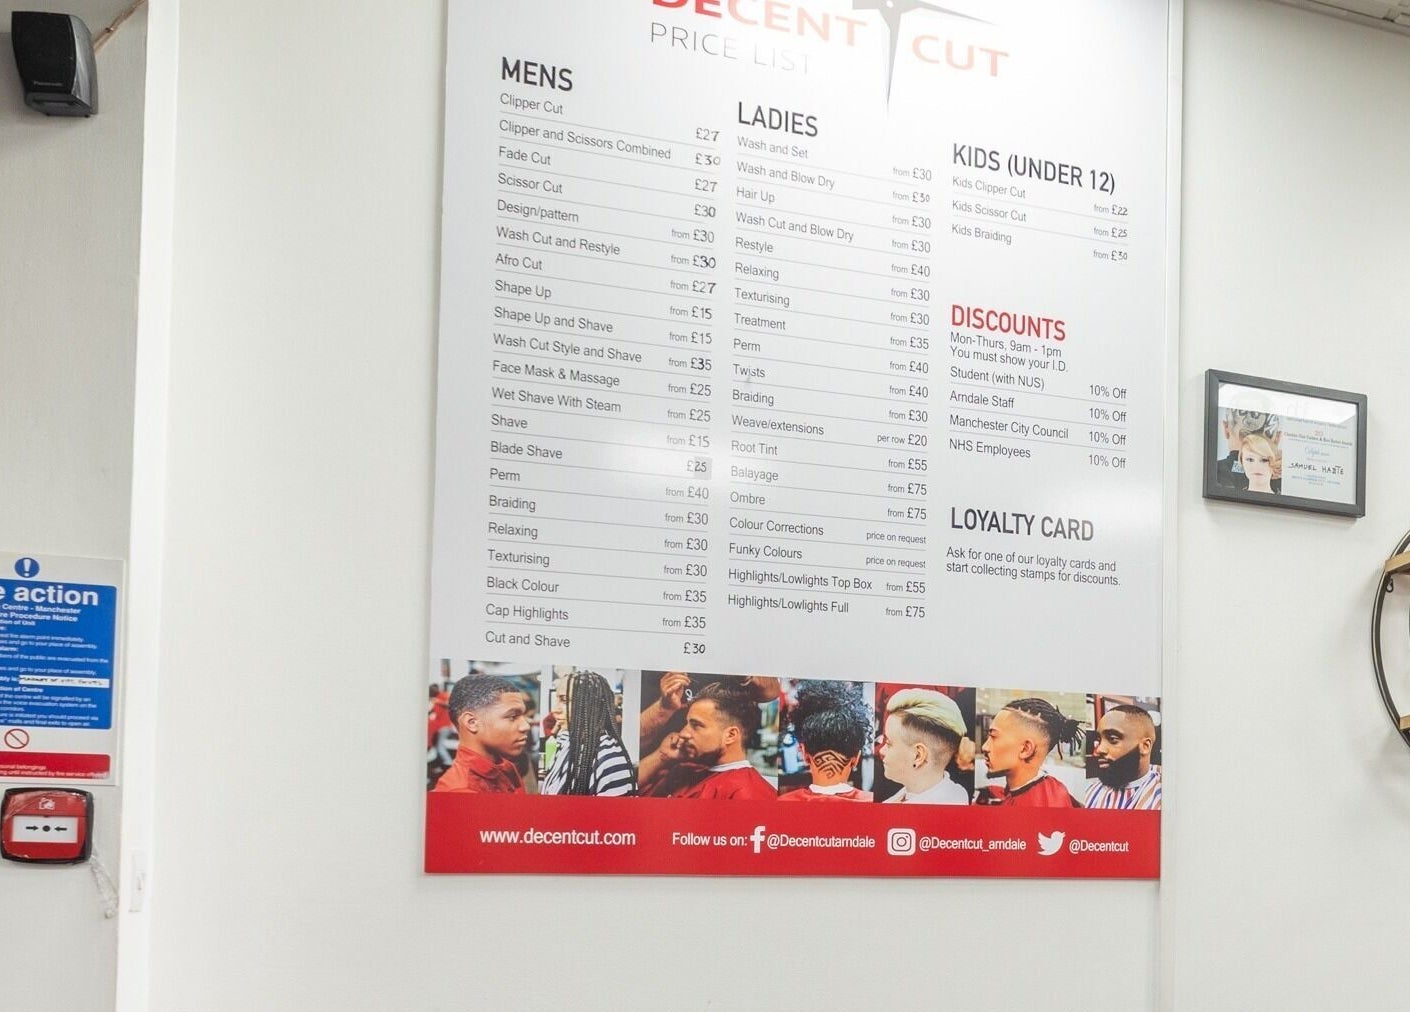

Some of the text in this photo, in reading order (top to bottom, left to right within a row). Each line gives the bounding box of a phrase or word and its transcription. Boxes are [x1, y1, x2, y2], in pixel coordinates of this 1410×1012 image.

[651, 0, 1009, 78] ECENT CUT
[651, 21, 810, 75] PRICE LIST
[501, 56, 573, 92] MENS
[500, 92, 719, 142] Clipper Cut £27
[738, 101, 818, 137] LADIES
[499, 119, 540, 138] Clipper
[543, 127, 564, 141] and
[567, 130, 613, 149] Scissors
[617, 140, 671, 160] Combined
[953, 143, 1115, 195] KIDS (UNDER 12)
[737, 187, 931, 229] Hair Up from £30
[953, 176, 973, 189] Kids
[975, 180, 1007, 195] Clipper
[1010, 186, 1026, 198] Cut
[1094, 204, 1109, 215] from
[497, 199, 714, 243] Design/pattern from £30
[953, 200, 972, 213] Kids
[975, 204, 1008, 219] Scissor
[1011, 210, 1026, 222] Cut
[1094, 227, 1109, 237] from
[952, 304, 1065, 342] DISCOUNTS
[950, 346, 970, 358] You
[973, 351, 997, 362] must
[1000, 354, 1025, 365] show
[1028, 358, 1050, 369] your
[1010, 340, 1031, 352] 9am
[1041, 345, 1061, 358] 1pm
[493, 361, 711, 397] Face Mask & Massage from £25
[950, 366, 1127, 399] Student (with NUS) 10% Off
[950, 390, 1127, 422] Arndale Staff 10% Off
[732, 415, 927, 446] Weave/extensions per row £20
[950, 414, 1126, 445] Manchester City Council 10% Off
[950, 439, 1126, 468] NHS Employees 10% Off
[731, 466, 927, 495] Balayage from £75
[730, 517, 926, 544] Colour Corrections price on request
[951, 507, 1094, 541] LOYALTY CARD
[947, 546, 1116, 572] Ask for one of our loyalty cards and
[947, 562, 1121, 586] start collecting stamps for discounts.
[14, 585, 98, 606] action
[729, 568, 925, 594] Highlights/Lowlights Top Box from £55
[10, 612, 51, 620] Procedure
[35, 606, 81, 614] Manchester
[486, 603, 706, 629] Cap Highlights from £35
[485, 631, 705, 655] Cut and Shave £30
[480, 828, 636, 846] www.decentcut.com
[672, 832, 875, 851] Follow us on: @Decentcutarndale
[919, 837, 1026, 852] @Decentcut_arndale
[1069, 840, 1129, 853] @Decentcut
